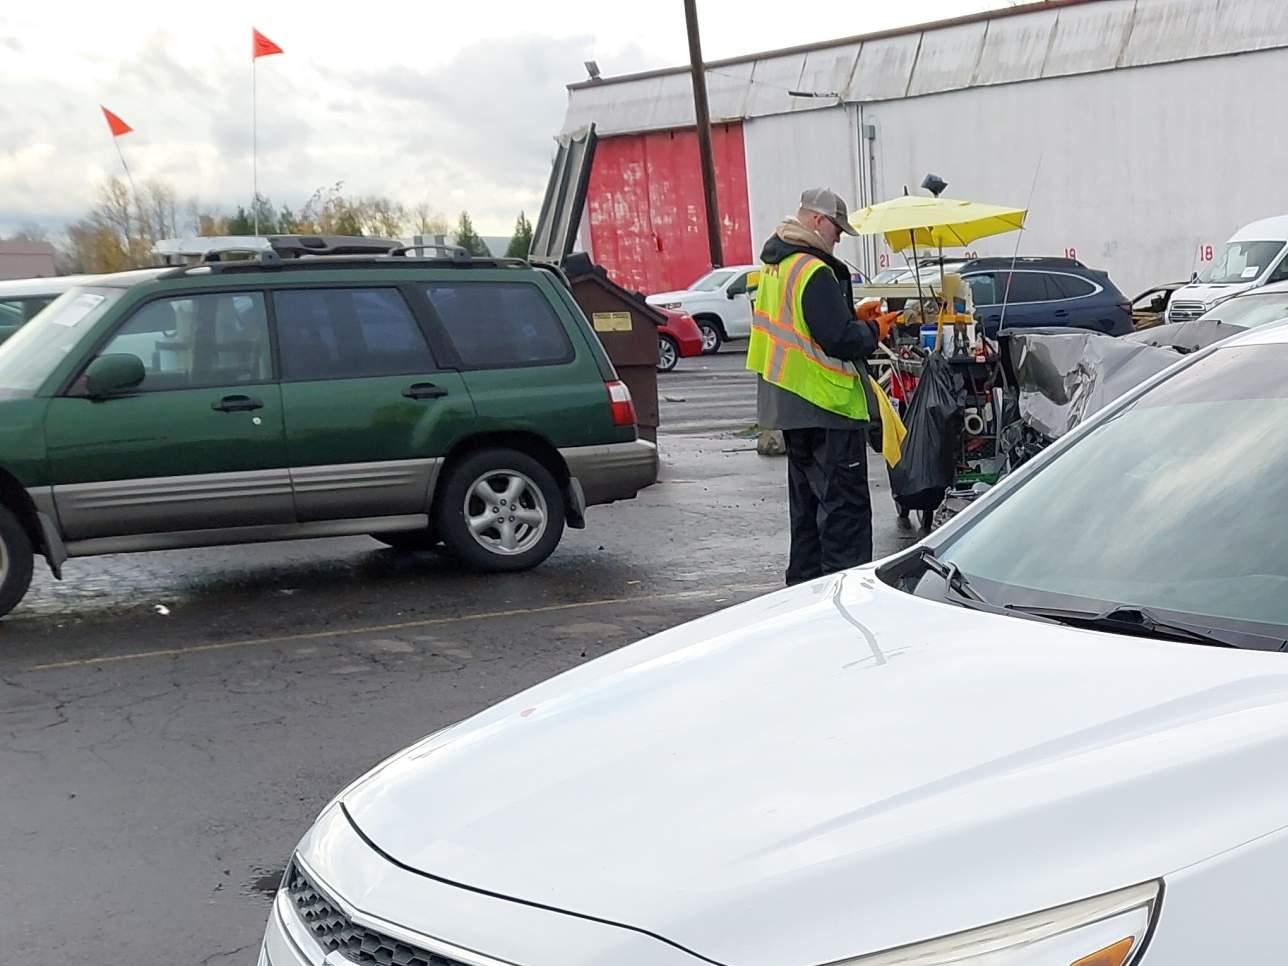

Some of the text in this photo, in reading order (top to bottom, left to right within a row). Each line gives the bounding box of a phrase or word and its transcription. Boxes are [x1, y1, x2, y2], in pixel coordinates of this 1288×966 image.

[1065, 248, 1076, 260] 19
[1200, 246, 1213, 261] 18
[880, 254, 890, 267] 21
